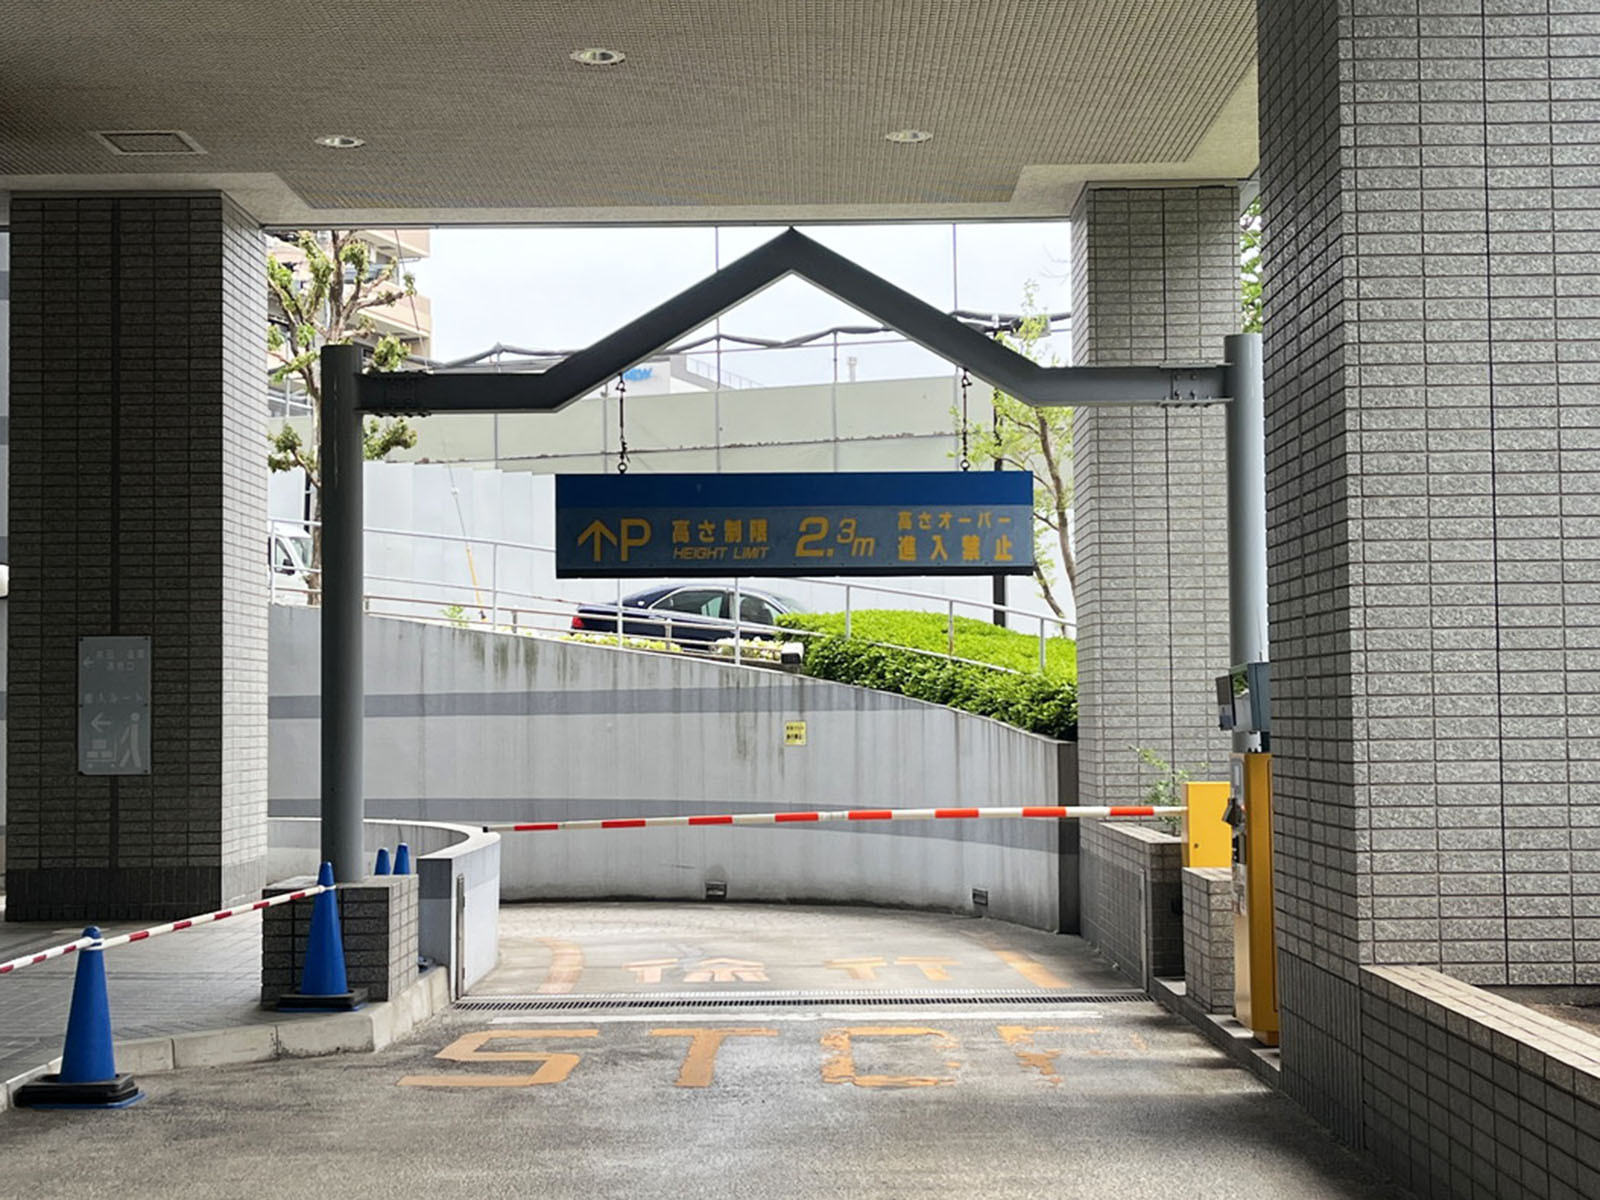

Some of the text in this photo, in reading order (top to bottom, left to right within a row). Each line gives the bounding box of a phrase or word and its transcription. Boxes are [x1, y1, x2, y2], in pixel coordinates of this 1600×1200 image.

[672, 519, 768, 543] 高さ制限
[898, 511, 1012, 530] 高さオーバー
[620, 518, 651, 562] P
[898, 534, 1013, 561] 進入禁止
[672, 546, 770, 560] HEIGHT LIMIT
